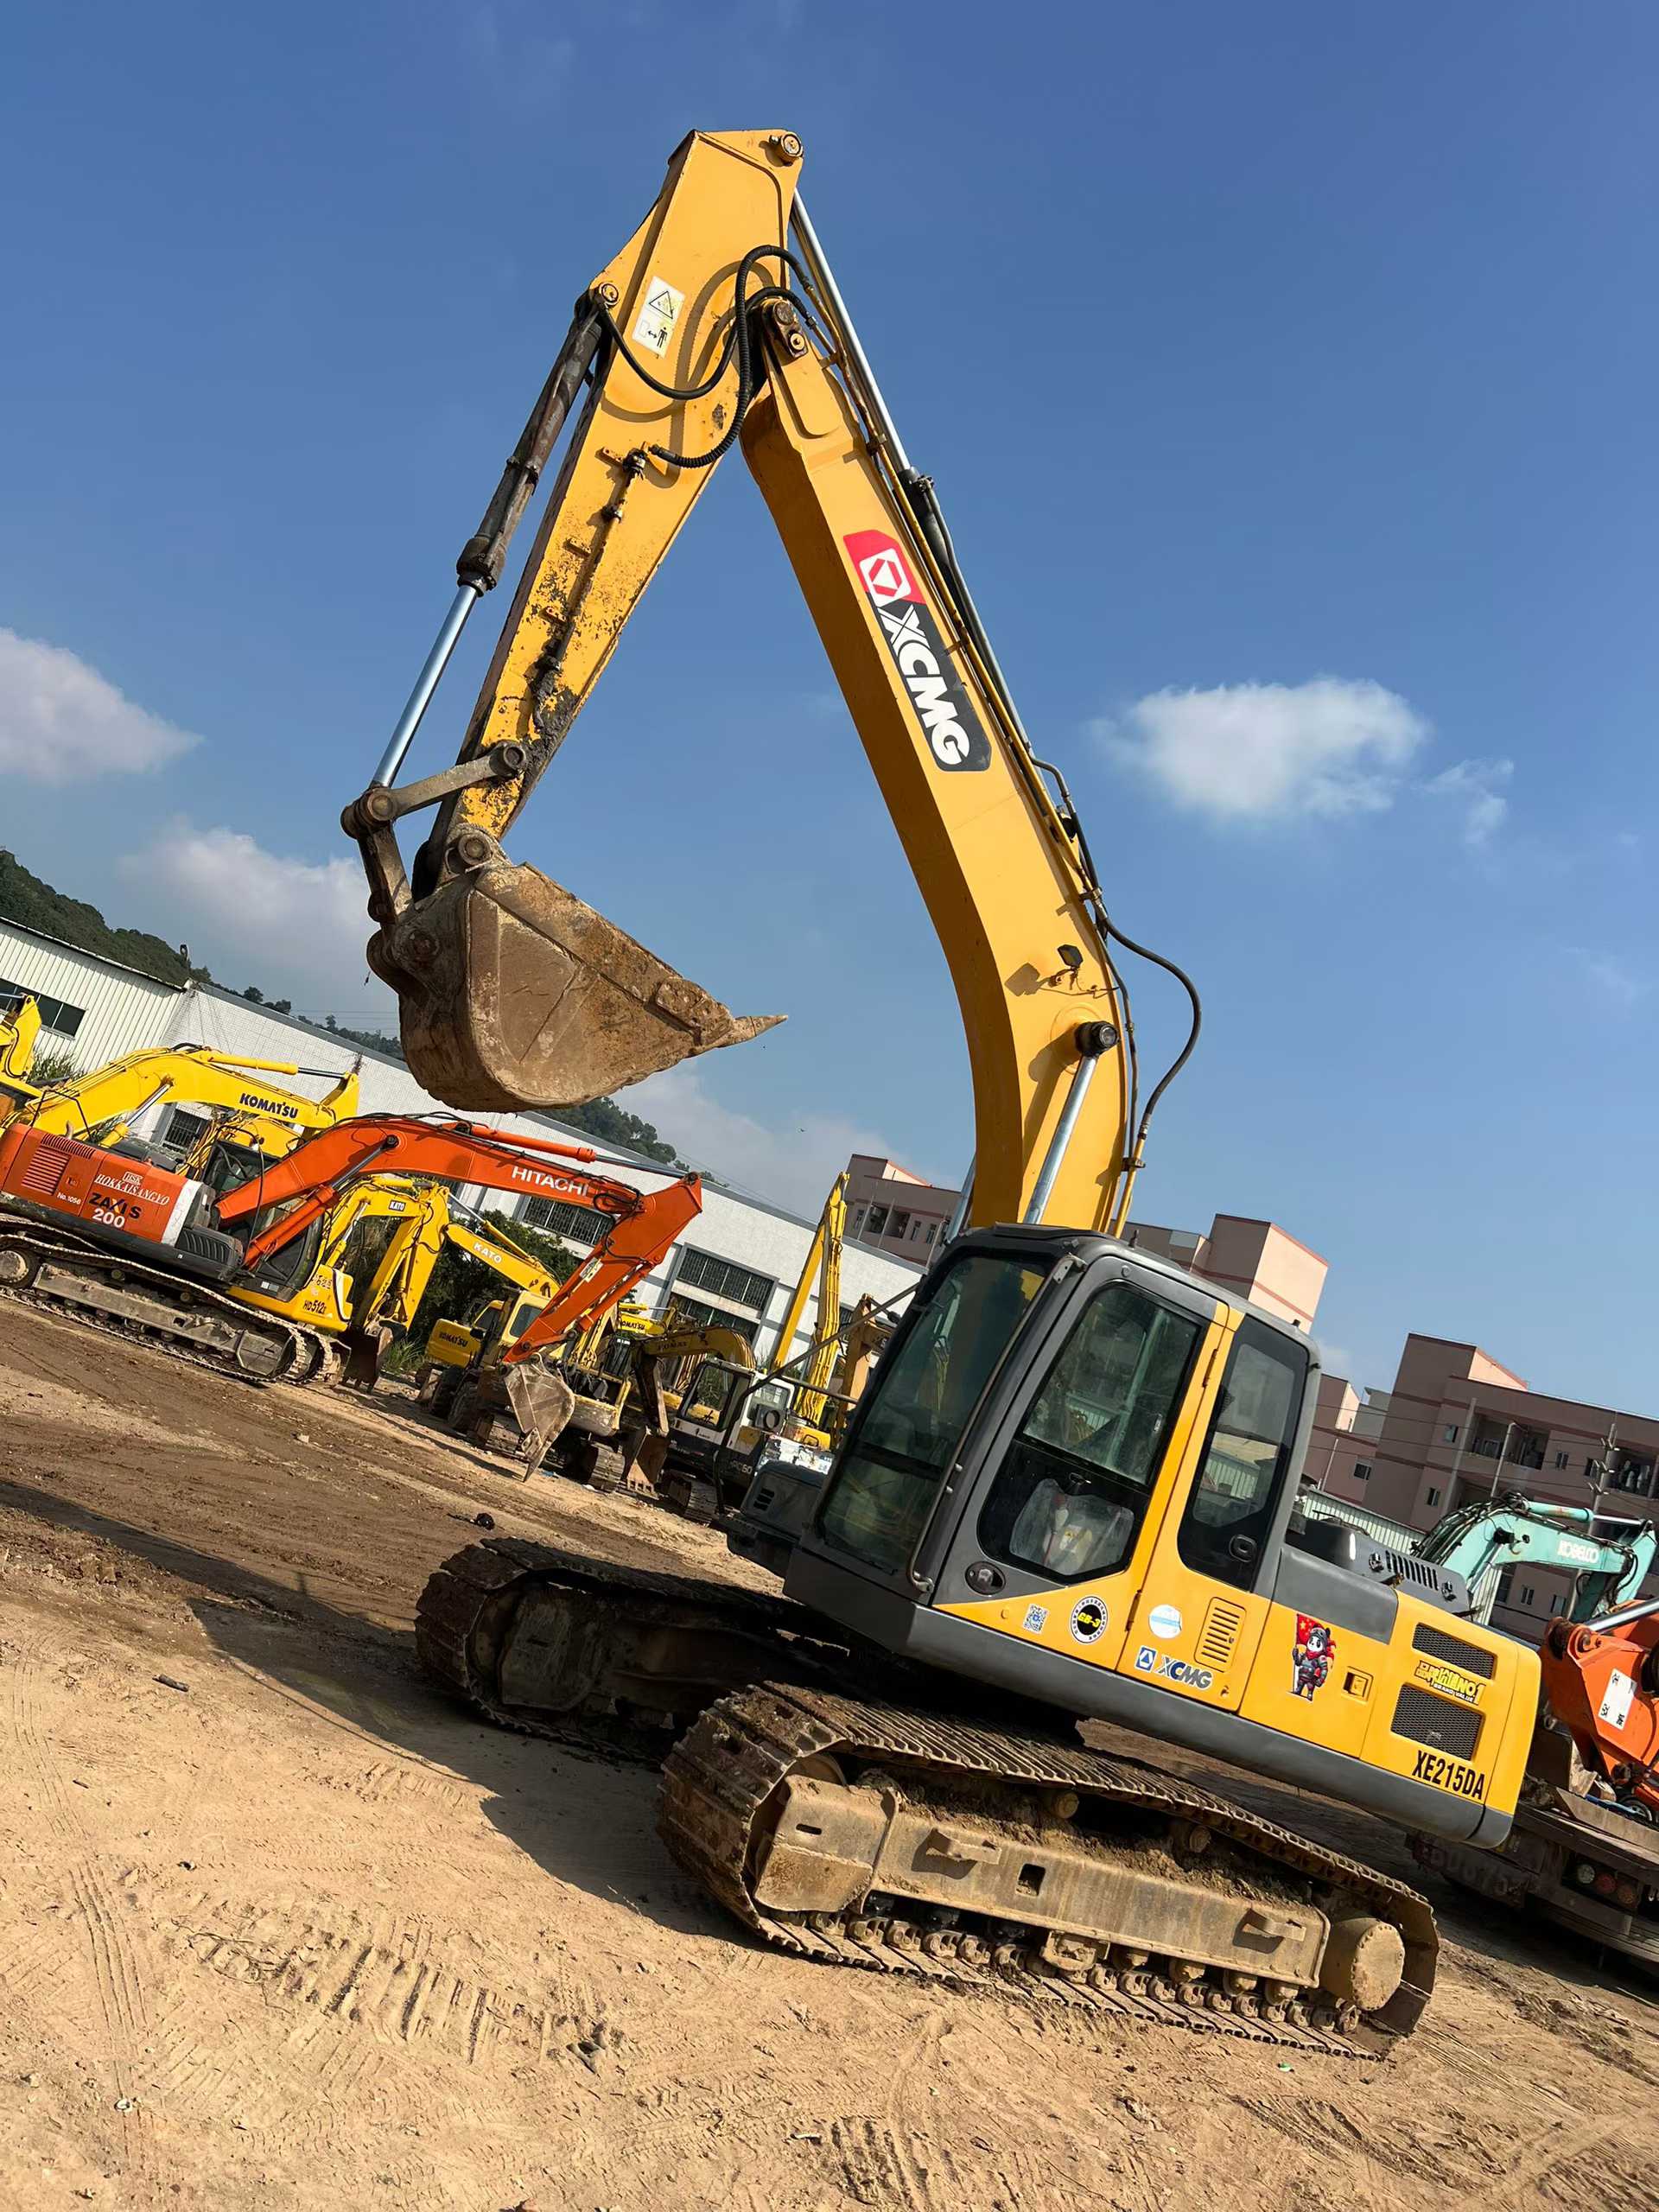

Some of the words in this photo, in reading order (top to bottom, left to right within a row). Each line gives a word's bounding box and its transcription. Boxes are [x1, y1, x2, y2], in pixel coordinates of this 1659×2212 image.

[877, 604, 969, 765] XCMG
[239, 1093, 299, 1119] KOMATSU
[512, 1166, 589, 1197] HITACHI
[89, 1192, 143, 1219] ZAXIS
[92, 1208, 125, 1229] 200
[390, 1201, 405, 1211] KATO
[474, 1243, 503, 1264] KATO
[620, 1319, 645, 1330] OMATSU
[1558, 1539, 1599, 1563] KOBELCO
[1157, 1655, 1211, 1688] XCMG
[1411, 1749, 1485, 1801] XE215DA
